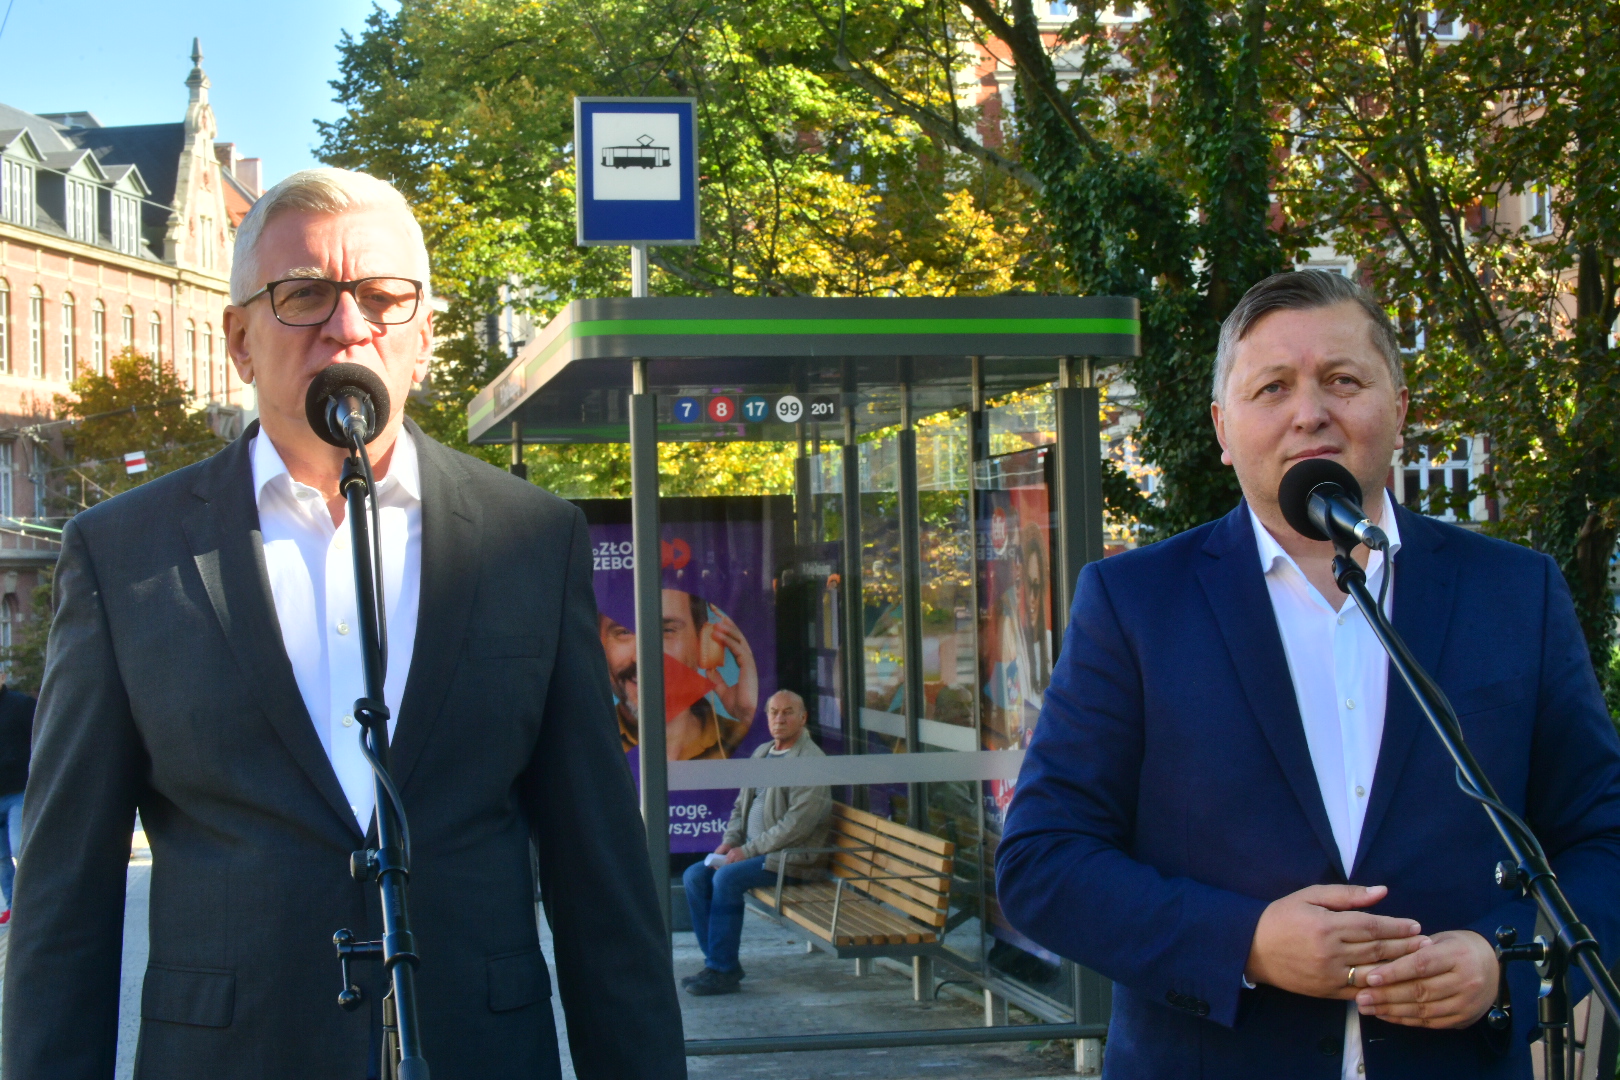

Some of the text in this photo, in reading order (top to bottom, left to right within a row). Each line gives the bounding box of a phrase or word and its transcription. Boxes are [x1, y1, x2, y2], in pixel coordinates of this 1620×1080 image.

[681, 402, 834, 417] 7 8 17 99 201
